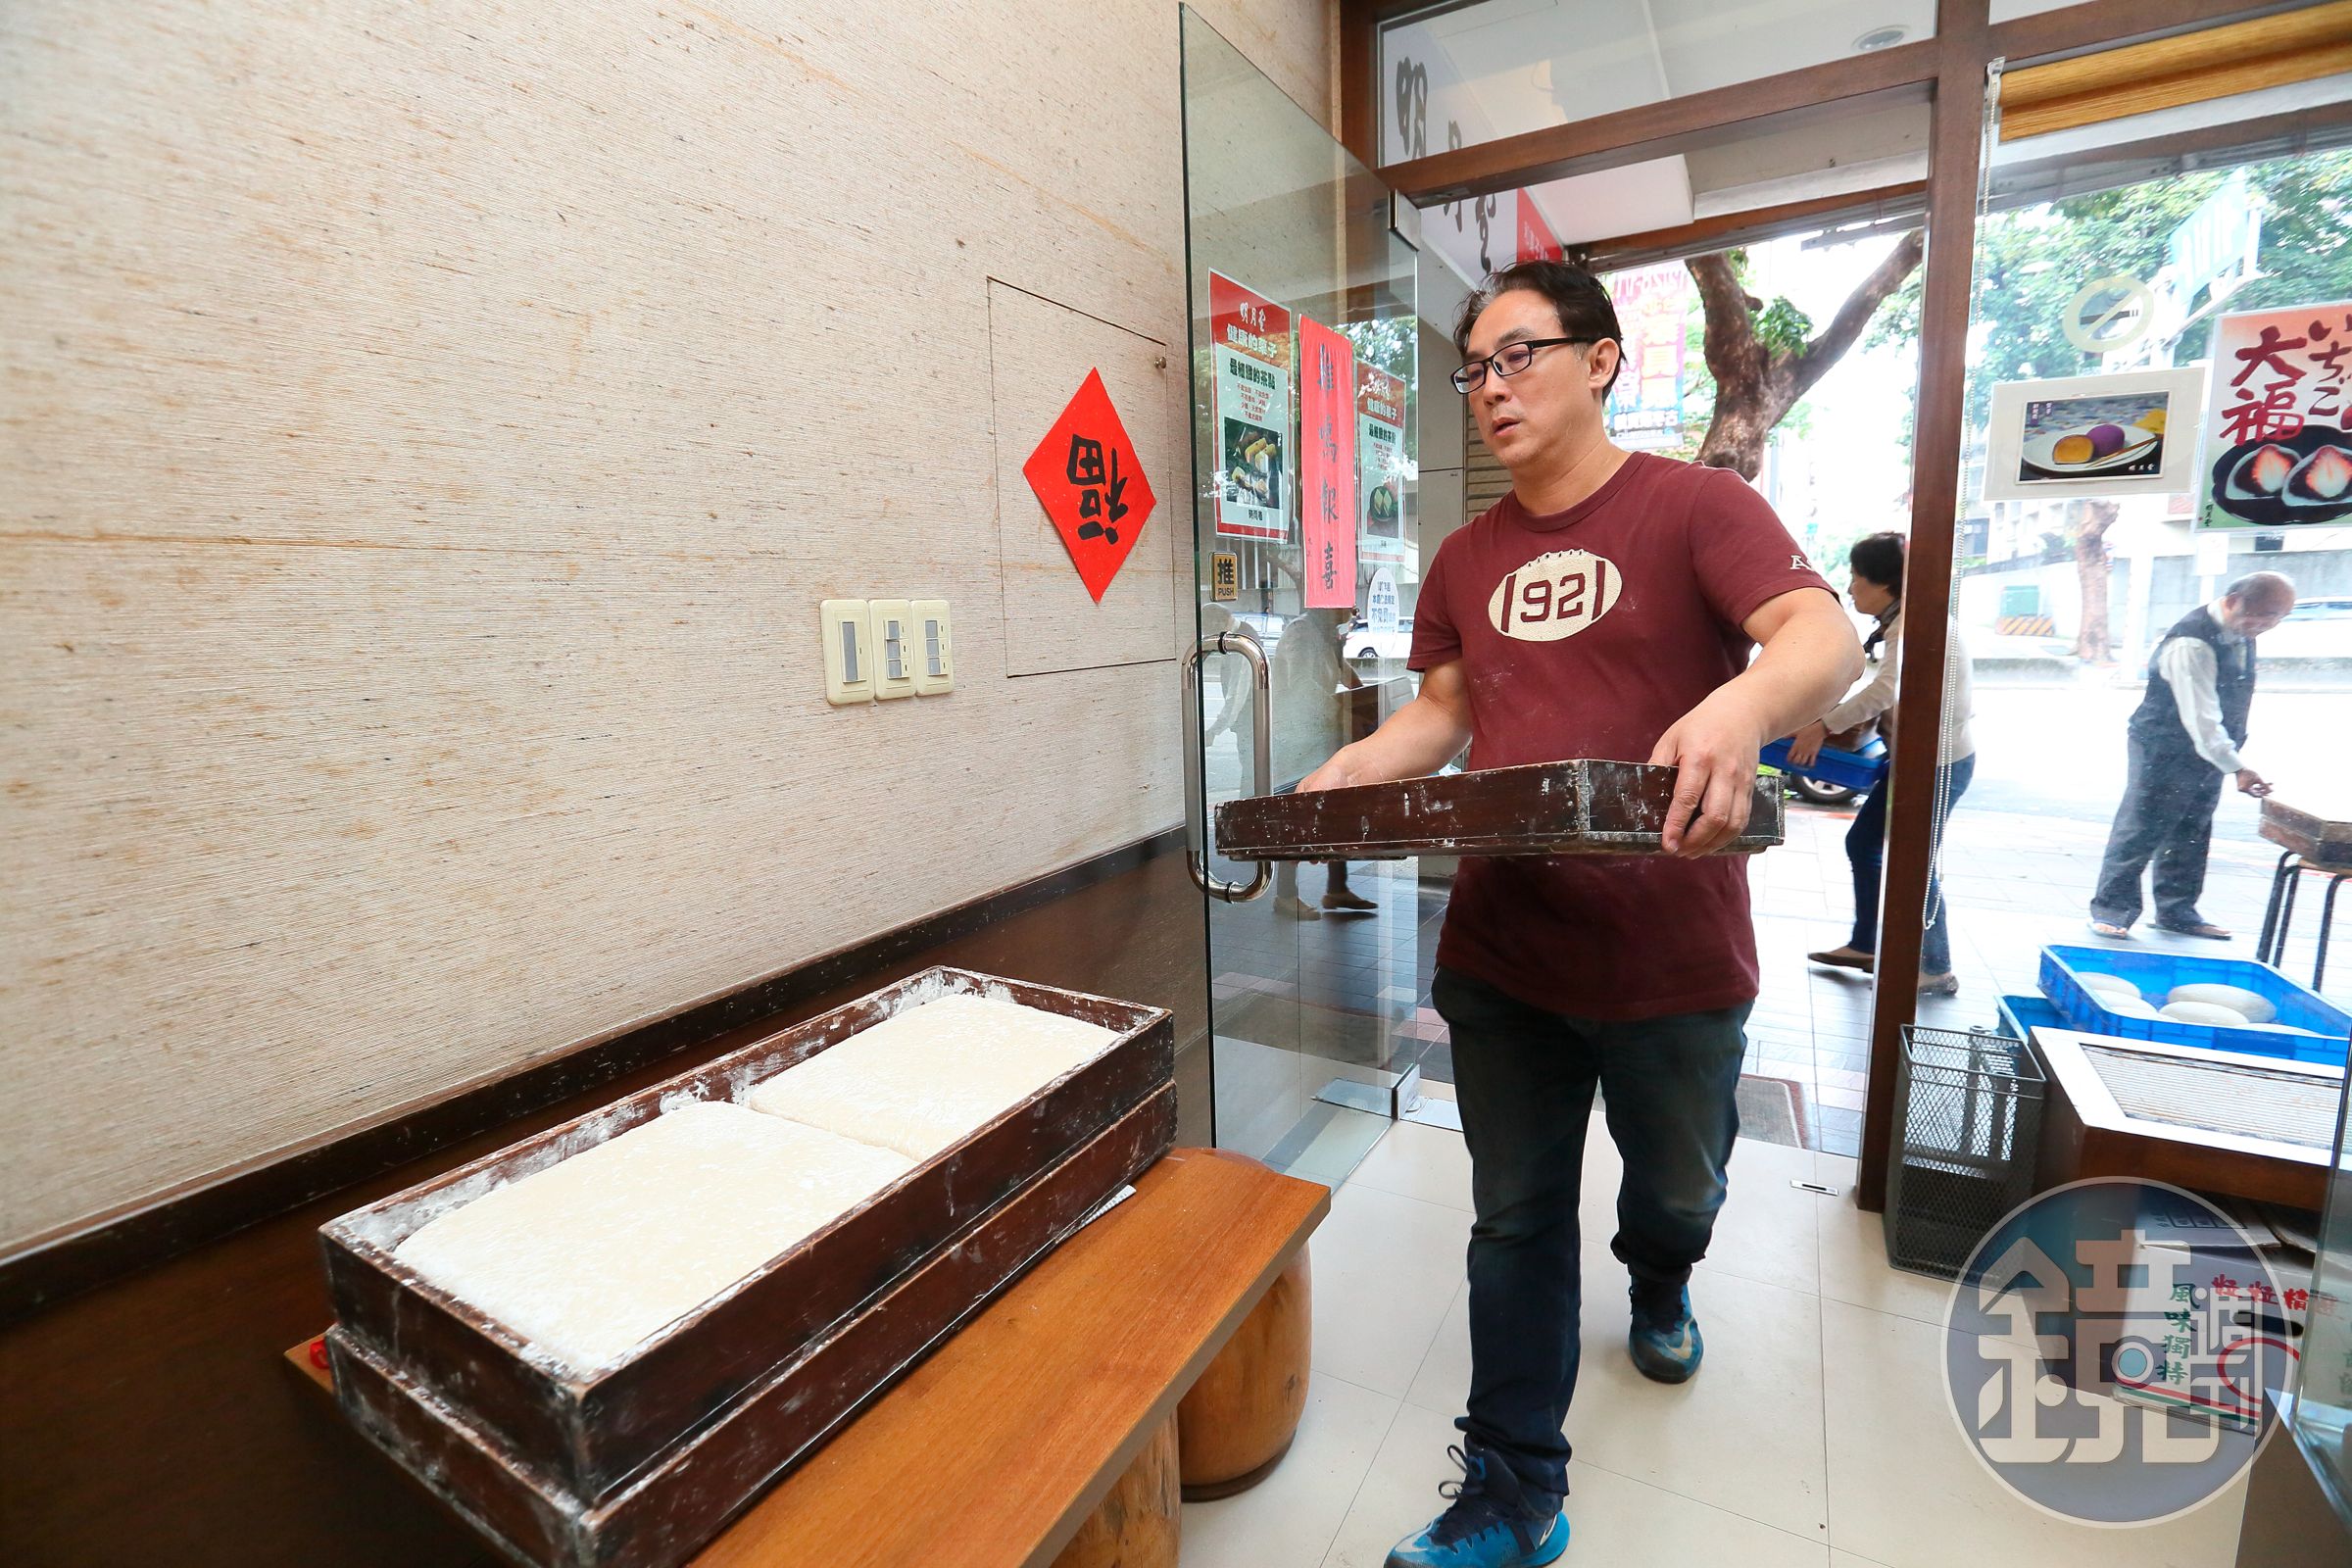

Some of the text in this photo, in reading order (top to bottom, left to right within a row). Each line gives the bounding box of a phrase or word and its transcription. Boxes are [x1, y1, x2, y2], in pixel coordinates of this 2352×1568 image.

[2219, 325, 2308, 446] 大福
[1066, 434, 1129, 546] 福
[1217, 559, 1235, 584] 推
[1217, 587, 1235, 596] PUSH
[2156, 1283, 2201, 1385] 風味獨特
